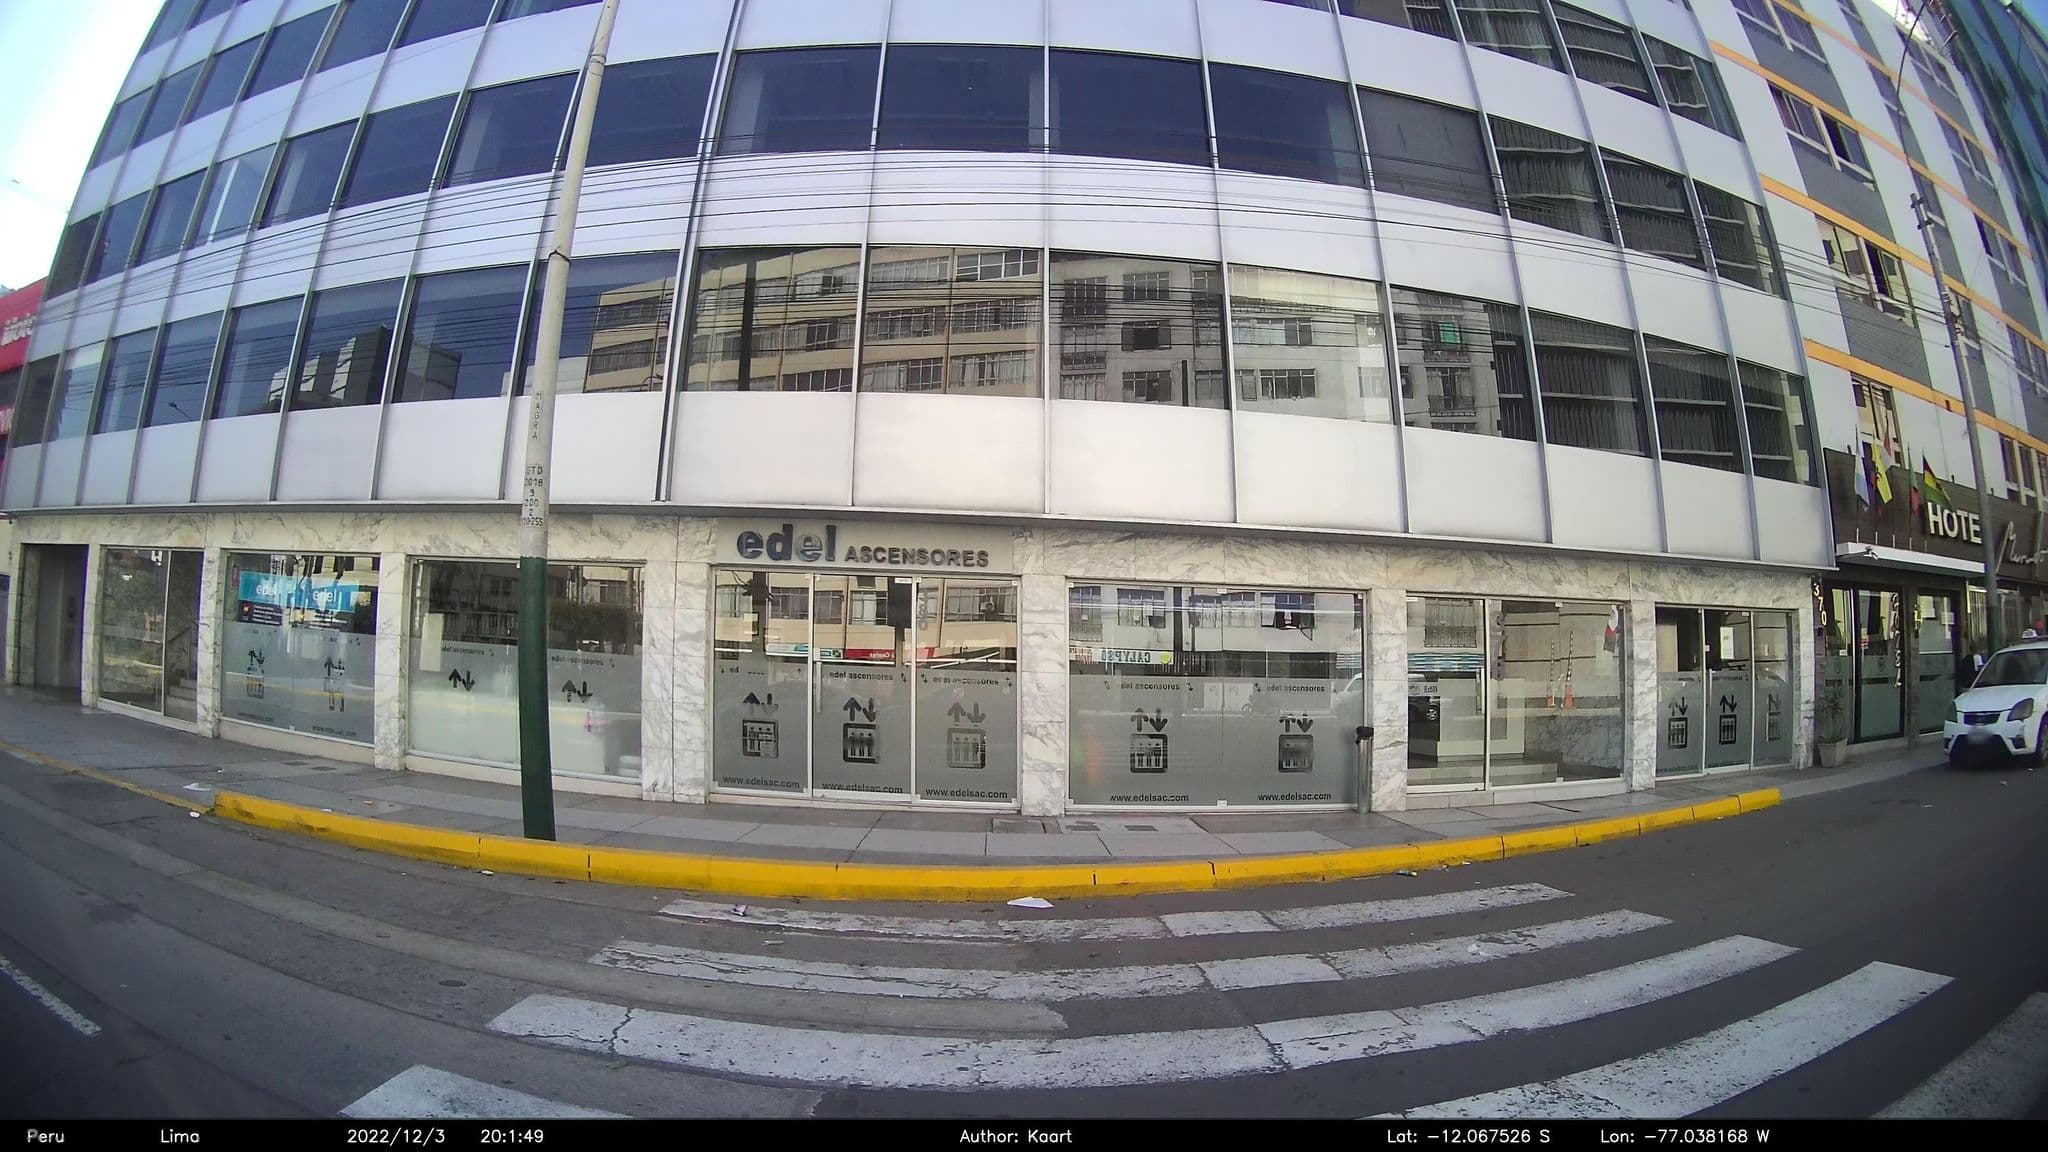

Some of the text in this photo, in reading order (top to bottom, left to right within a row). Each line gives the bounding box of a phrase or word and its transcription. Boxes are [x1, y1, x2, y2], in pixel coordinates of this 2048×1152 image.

[1927, 501, 1983, 544] HOTE
[736, 523, 989, 567] edel ASCENSORES
[312, 588, 337, 603] edel
[829, 671, 894, 682] edel ascensores
[722, 774, 800, 789] www.edelsac.com
[822, 781, 903, 794] www.edelsac.com
[925, 786, 1008, 799] www.edelsac.com
[1110, 793, 1189, 802] www.edelsac.com
[1258, 791, 1332, 801] www.edelsac.com
